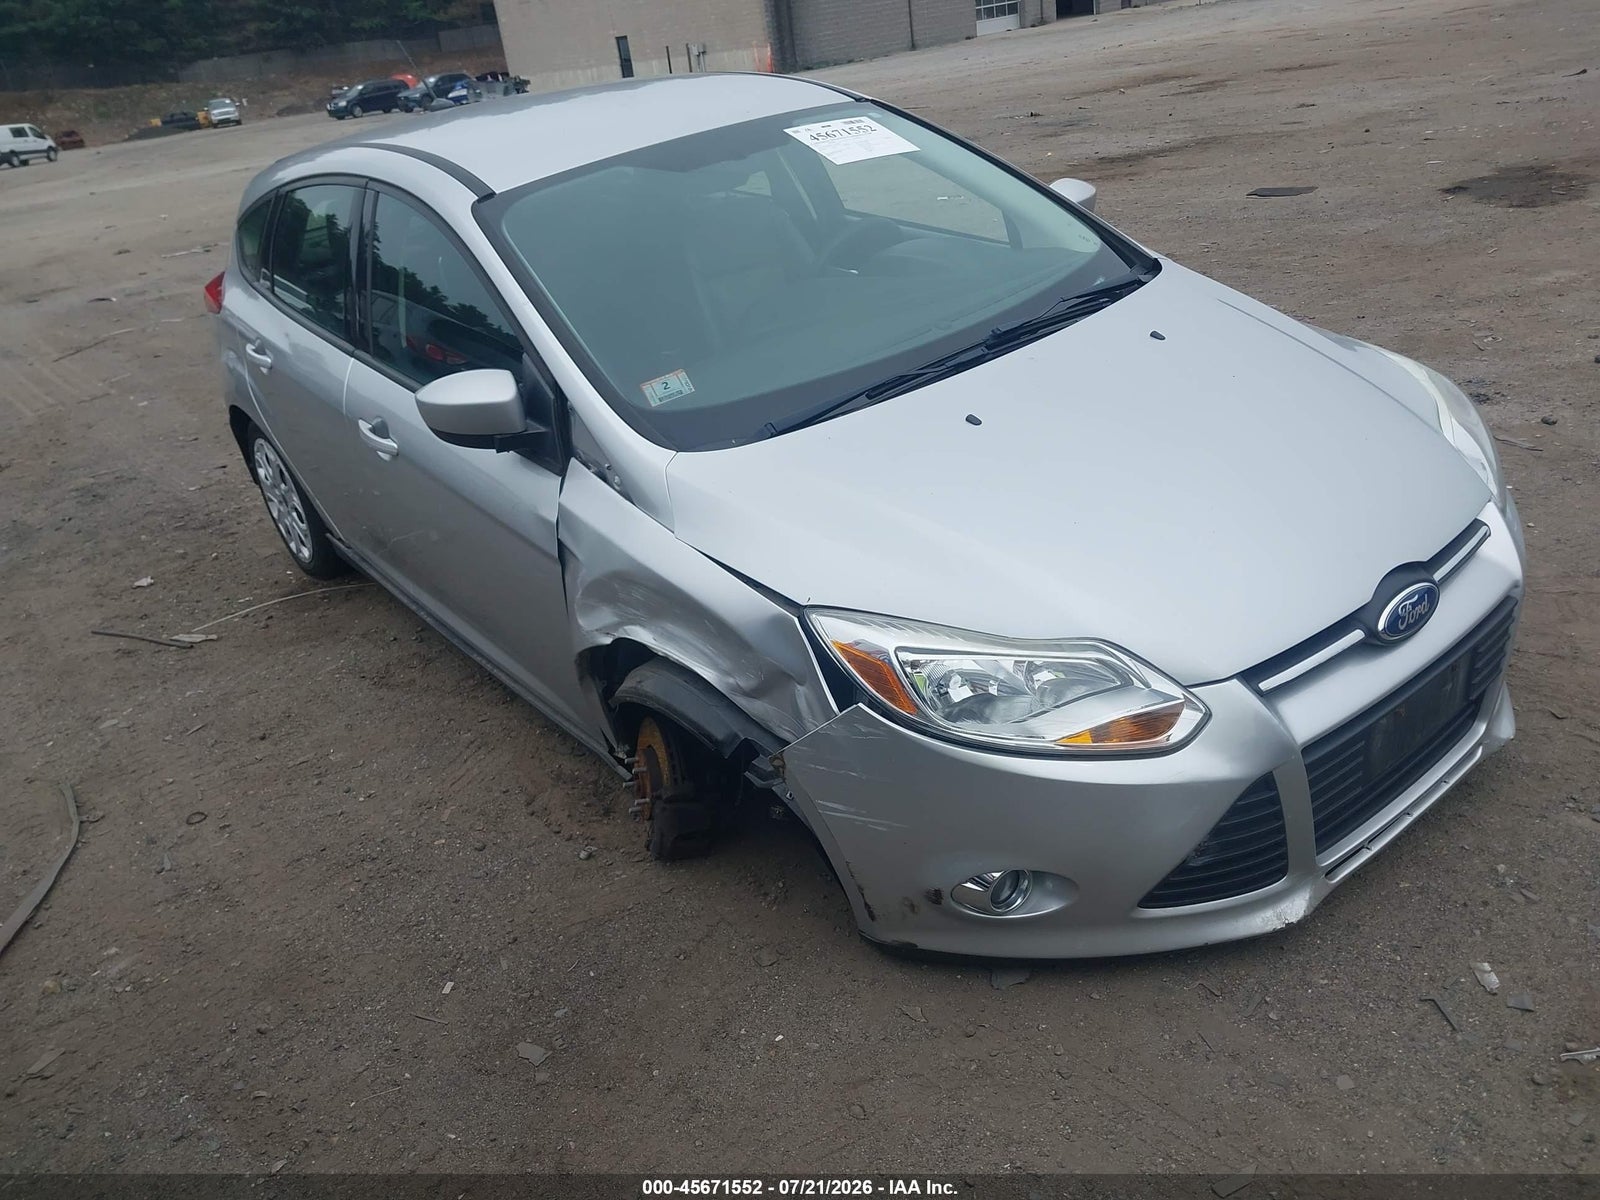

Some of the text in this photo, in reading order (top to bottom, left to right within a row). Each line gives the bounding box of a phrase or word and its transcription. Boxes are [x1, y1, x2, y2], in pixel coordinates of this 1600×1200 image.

[809, 124, 877, 142] 45671552
[661, 381, 671, 390] 2
[1398, 593, 1430, 630] Ford
